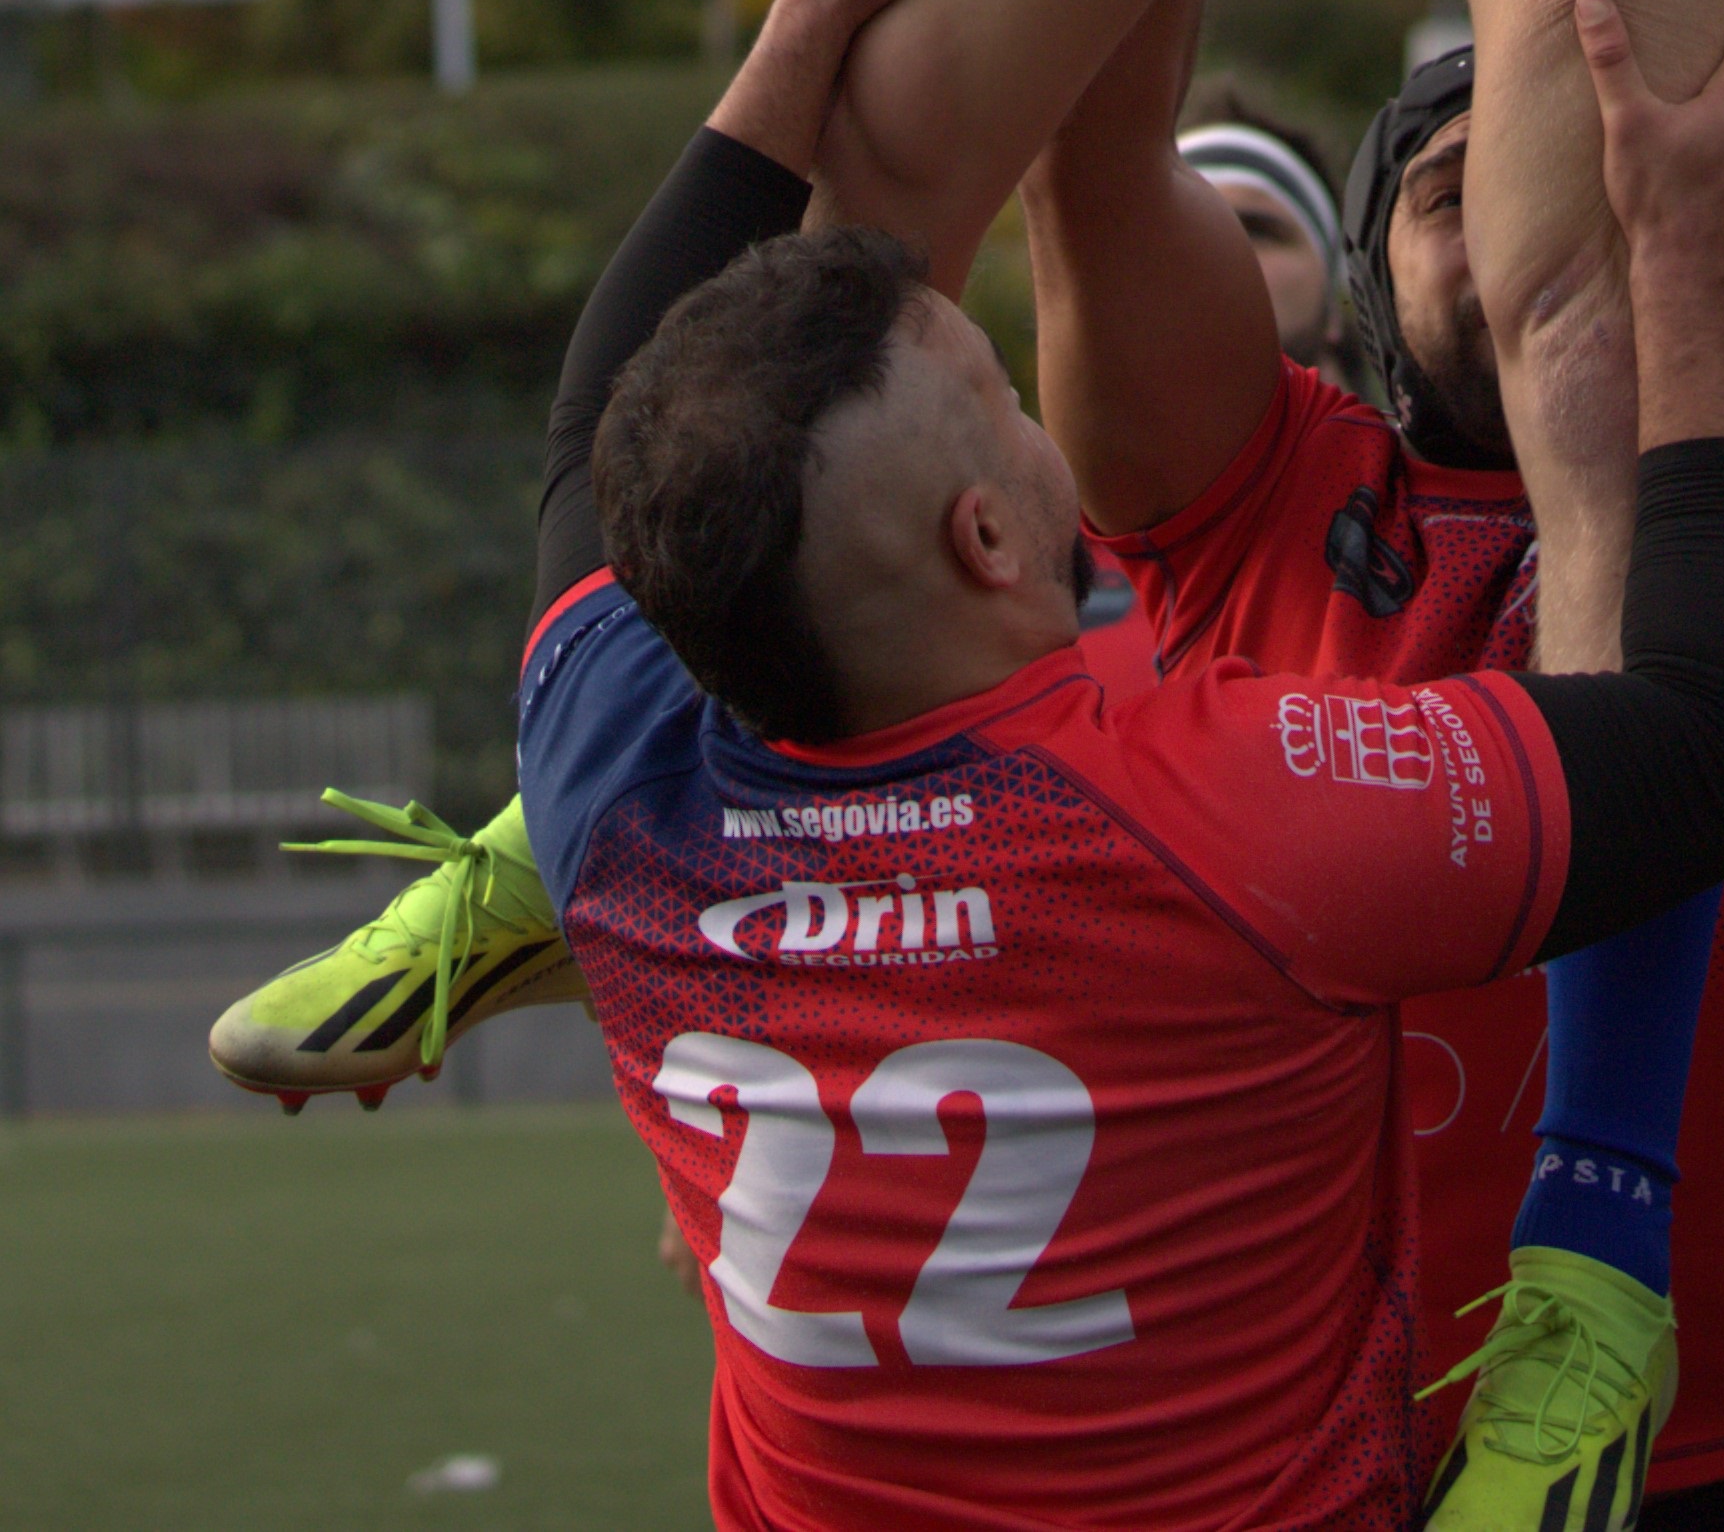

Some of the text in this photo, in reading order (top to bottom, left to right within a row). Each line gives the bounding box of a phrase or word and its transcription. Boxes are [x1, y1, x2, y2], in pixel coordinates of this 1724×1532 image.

[1415, 687, 1493, 842] DE SEGOVIA
[723, 793, 975, 843] www.segovia.es
[777, 873, 997, 952] Drin
[778, 946, 999, 967] SEGURIDAD
[652, 1031, 1137, 1368] 22
[1531, 1153, 1652, 1205] PSTA
